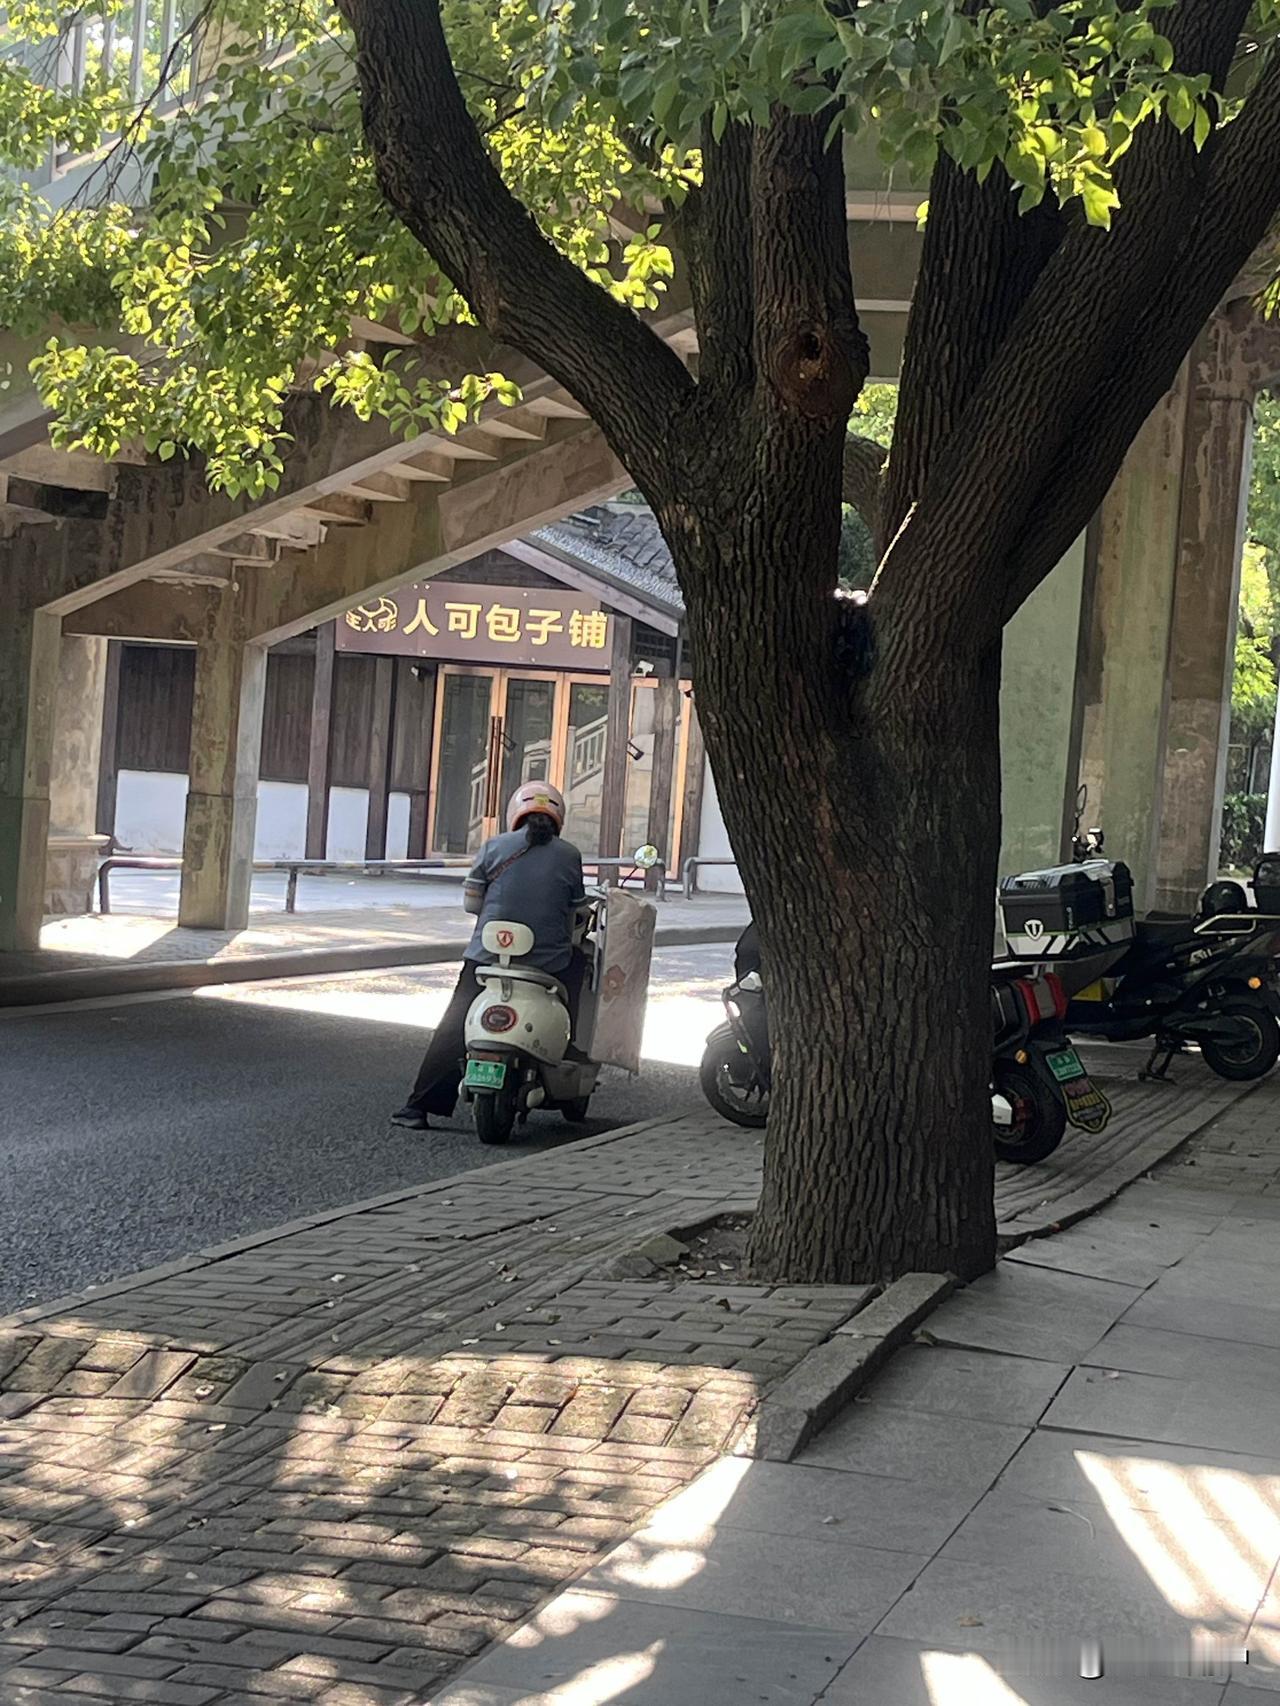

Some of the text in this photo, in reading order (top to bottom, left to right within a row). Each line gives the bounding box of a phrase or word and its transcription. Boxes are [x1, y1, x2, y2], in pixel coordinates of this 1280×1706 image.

[403, 599, 608, 649] 人可包子铺
